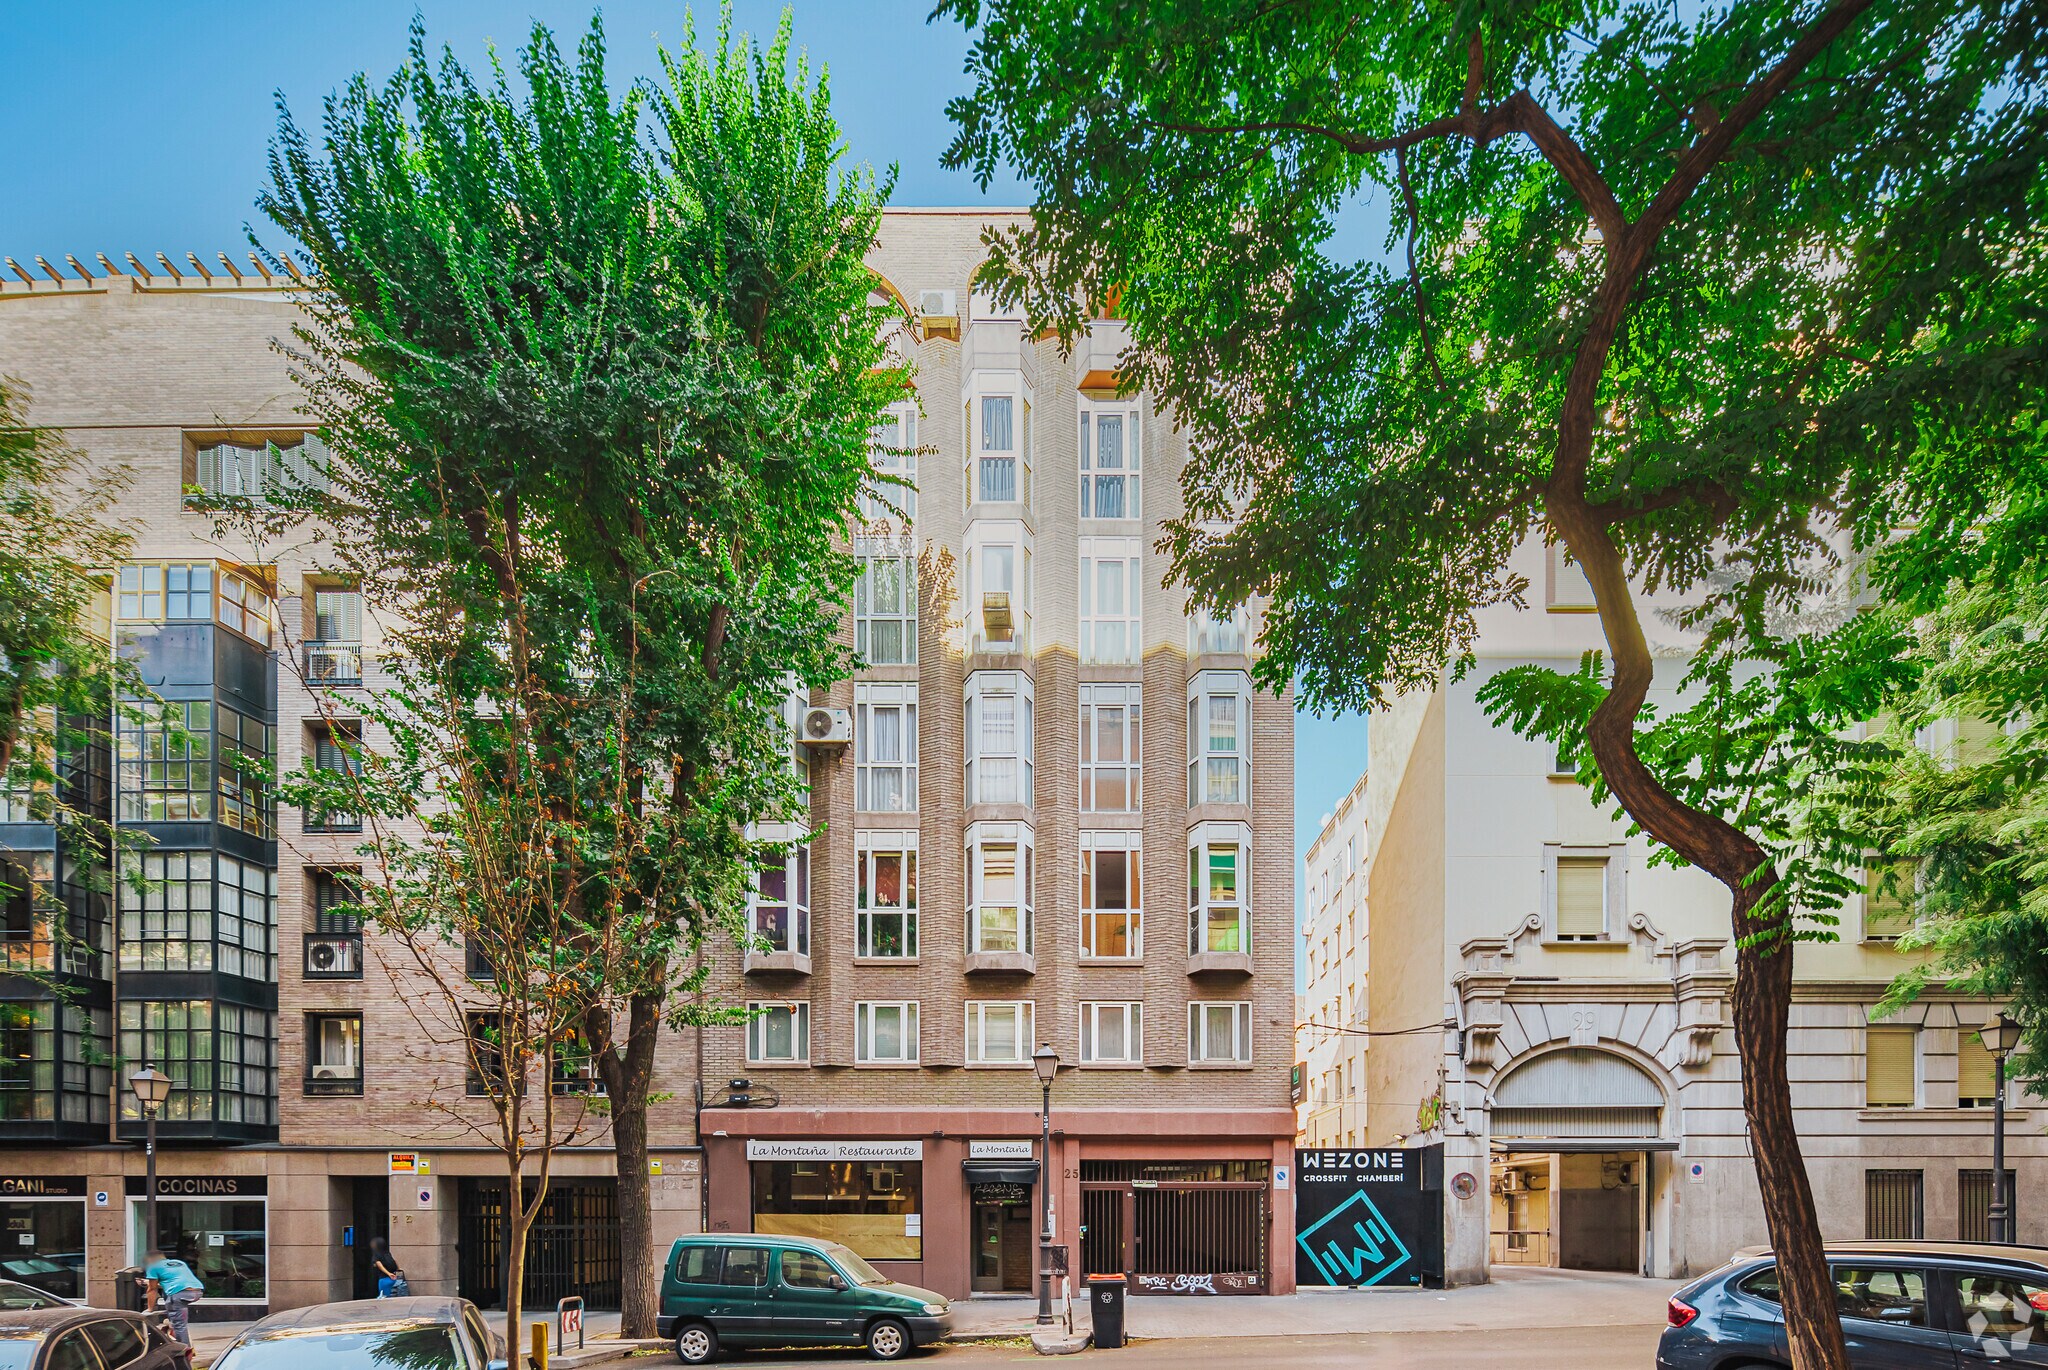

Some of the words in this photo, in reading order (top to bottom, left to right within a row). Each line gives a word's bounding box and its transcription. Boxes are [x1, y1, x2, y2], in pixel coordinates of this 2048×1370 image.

[1572, 1011, 1595, 1031] 29
[752, 1145, 769, 1156] La
[771, 1145, 830, 1156] Montaña
[839, 1145, 917, 1157] Restaurante
[971, 1145, 984, 1154] La
[985, 1145, 1030, 1154] Montaña
[1303, 1152, 1403, 1168] WEZONE
[1064, 1168, 1079, 1179] 25
[1303, 1174, 1348, 1182] CROSSFIT
[1356, 1173, 1404, 1182] CHAMBERÍ
[158, 1179, 238, 1193] COCINAS
